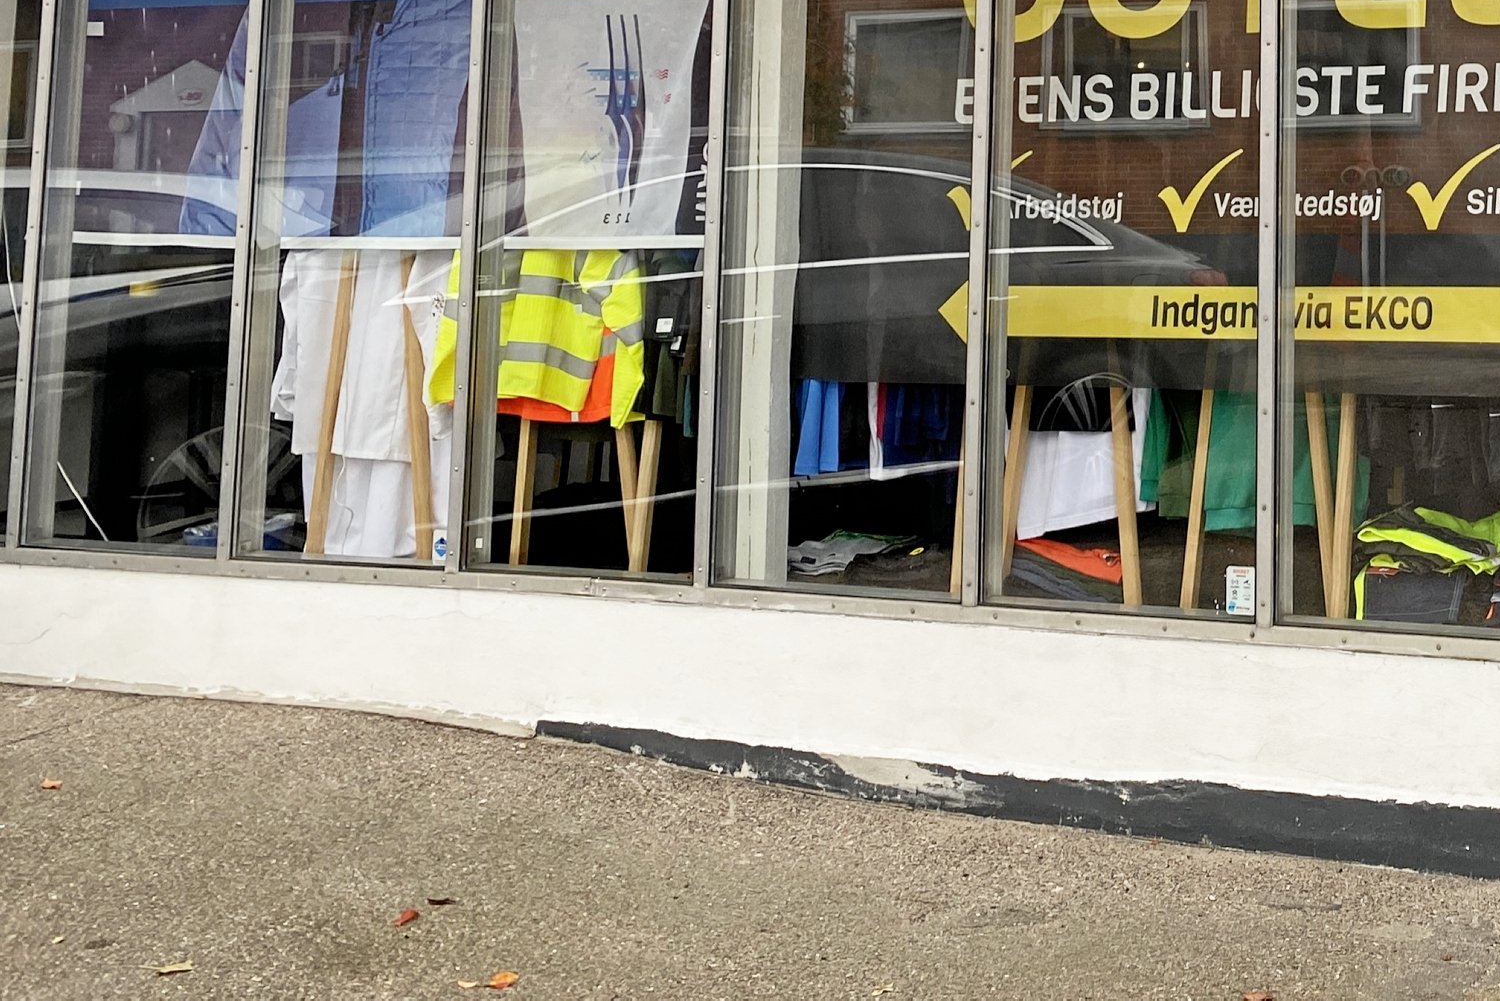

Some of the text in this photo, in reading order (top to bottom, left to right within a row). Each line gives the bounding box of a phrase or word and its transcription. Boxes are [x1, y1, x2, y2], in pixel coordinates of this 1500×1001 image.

[1129, 64, 1387, 121] BILLISTE
[1010, 192, 1123, 224] rbejdstøj
[1151, 293, 1259, 335] Indgan
[1345, 296, 1434, 330] EKCO
